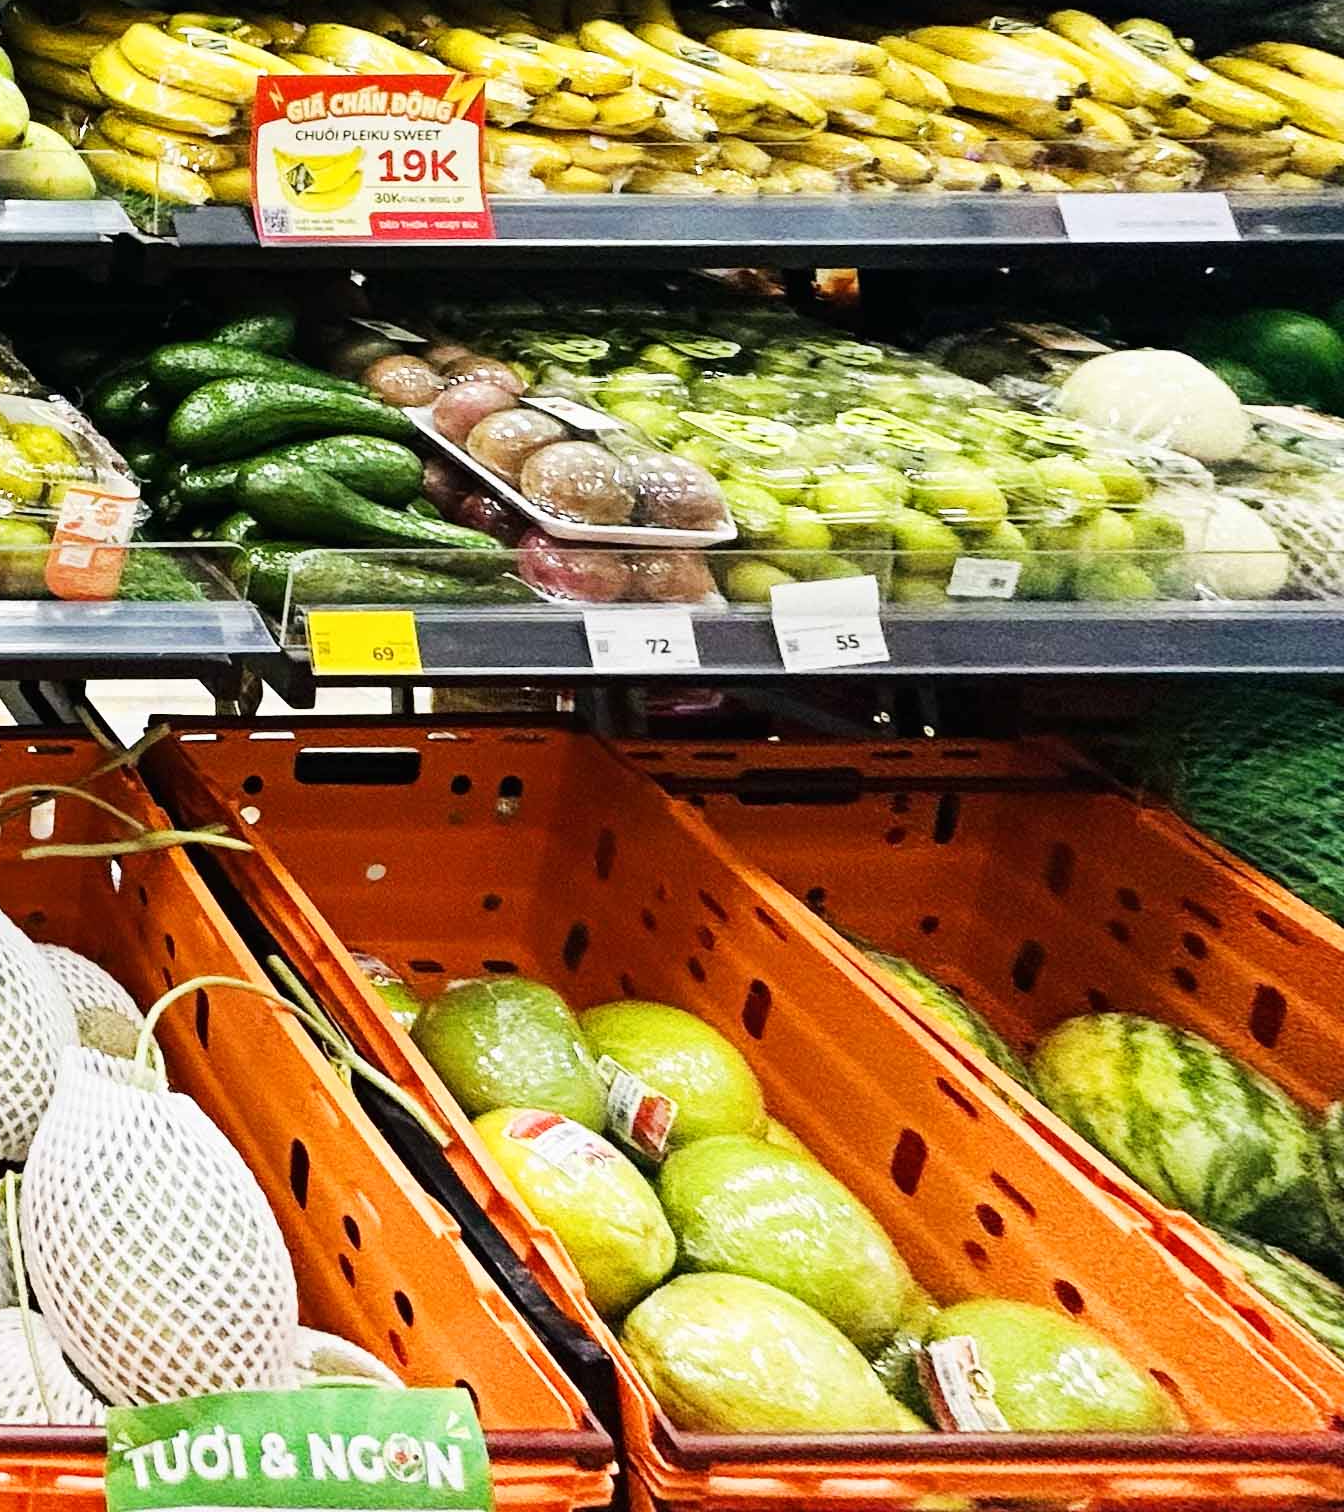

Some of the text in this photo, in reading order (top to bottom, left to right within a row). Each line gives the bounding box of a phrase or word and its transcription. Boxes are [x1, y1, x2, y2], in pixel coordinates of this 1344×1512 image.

[287, 86, 455, 123] GIÁ CHẤN ĐỘNG
[342, 129, 390, 141] PLEIKU
[393, 129, 441, 141] SWEET
[377, 149, 459, 182] 19K
[645, 638, 672, 655] 72
[835, 634, 860, 651] 55
[372, 646, 395, 661] 69
[123, 1424, 249, 1490] TƯƠI
[259, 1431, 298, 1481] &
